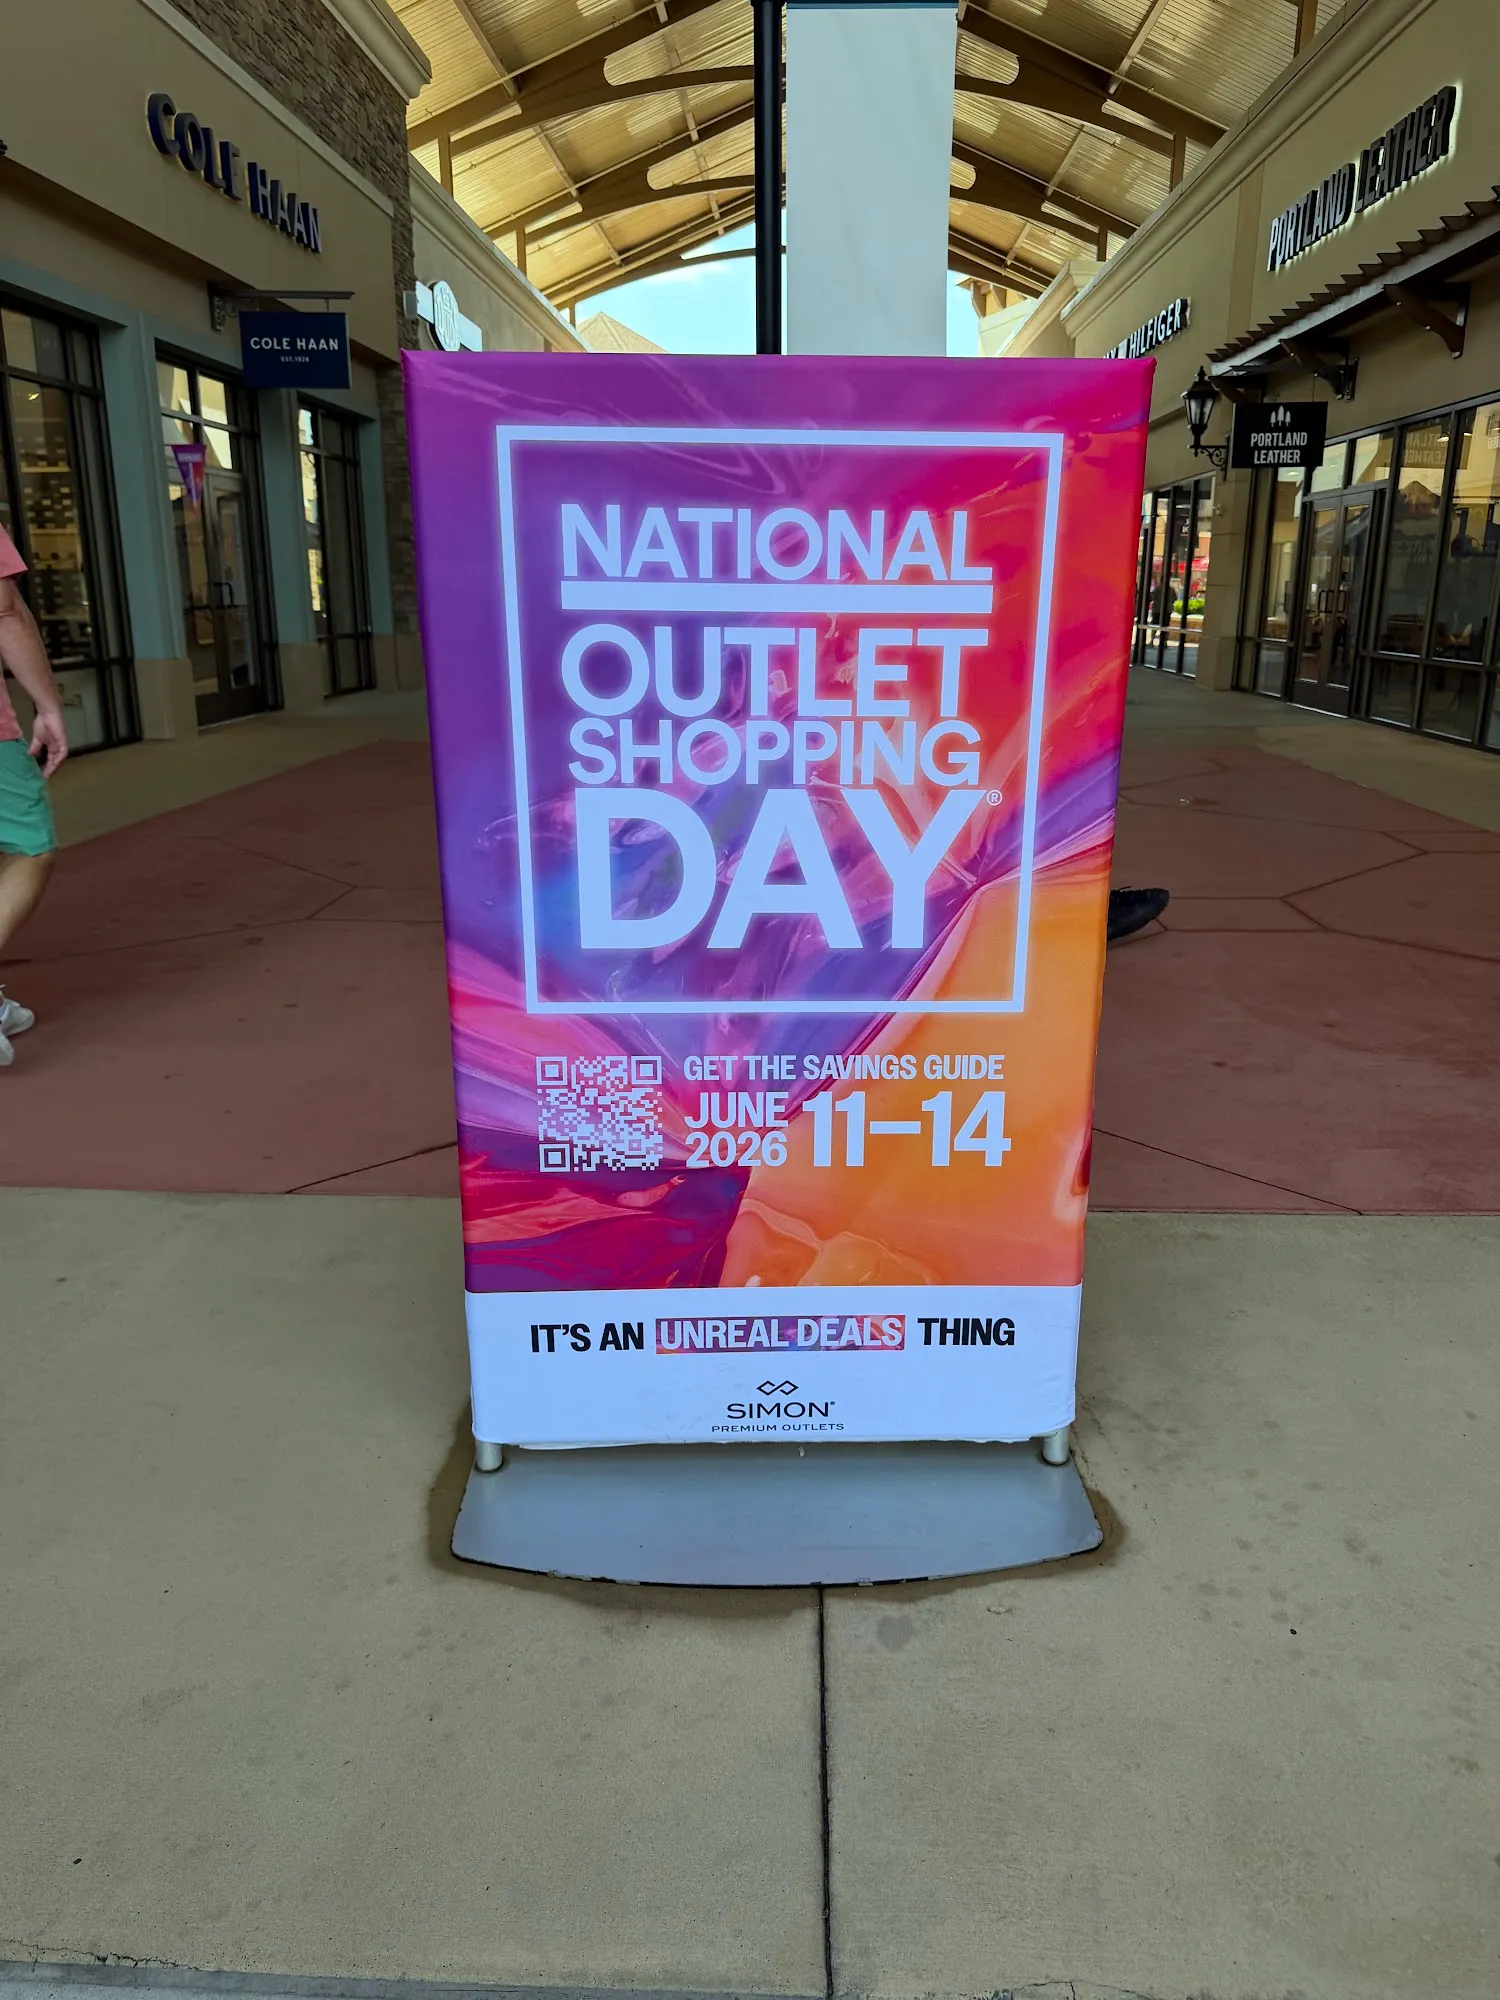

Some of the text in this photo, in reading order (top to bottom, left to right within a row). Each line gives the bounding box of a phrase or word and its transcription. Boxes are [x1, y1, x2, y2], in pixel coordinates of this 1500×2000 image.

[147, 93, 322, 254] COLE HAAN
[1267, 85, 1457, 272] PORTLAND LEATHER
[250, 337, 339, 351] COLE HAAN
[1129, 298, 1184, 358] HILFIGER
[1250, 432, 1308, 447] PORTLAND
[1253, 449, 1301, 464] LEATHER
[561, 503, 994, 581] NATIONAL
[561, 623, 989, 718] OUTLET
[568, 717, 981, 787] SHOPPING
[684, 1054, 1005, 1081] GET THE SAVINGS GUIDE
[684, 1091, 789, 1129] JUNE
[685, 1131, 788, 1168] 2026
[598, 1322, 644, 1351] AN
[660, 1318, 789, 1350] UNREAL
[797, 1317, 902, 1347] DEALS
[917, 1317, 1016, 1346] THING
[711, 1423, 845, 1433] PREMIUM OUTLETS
